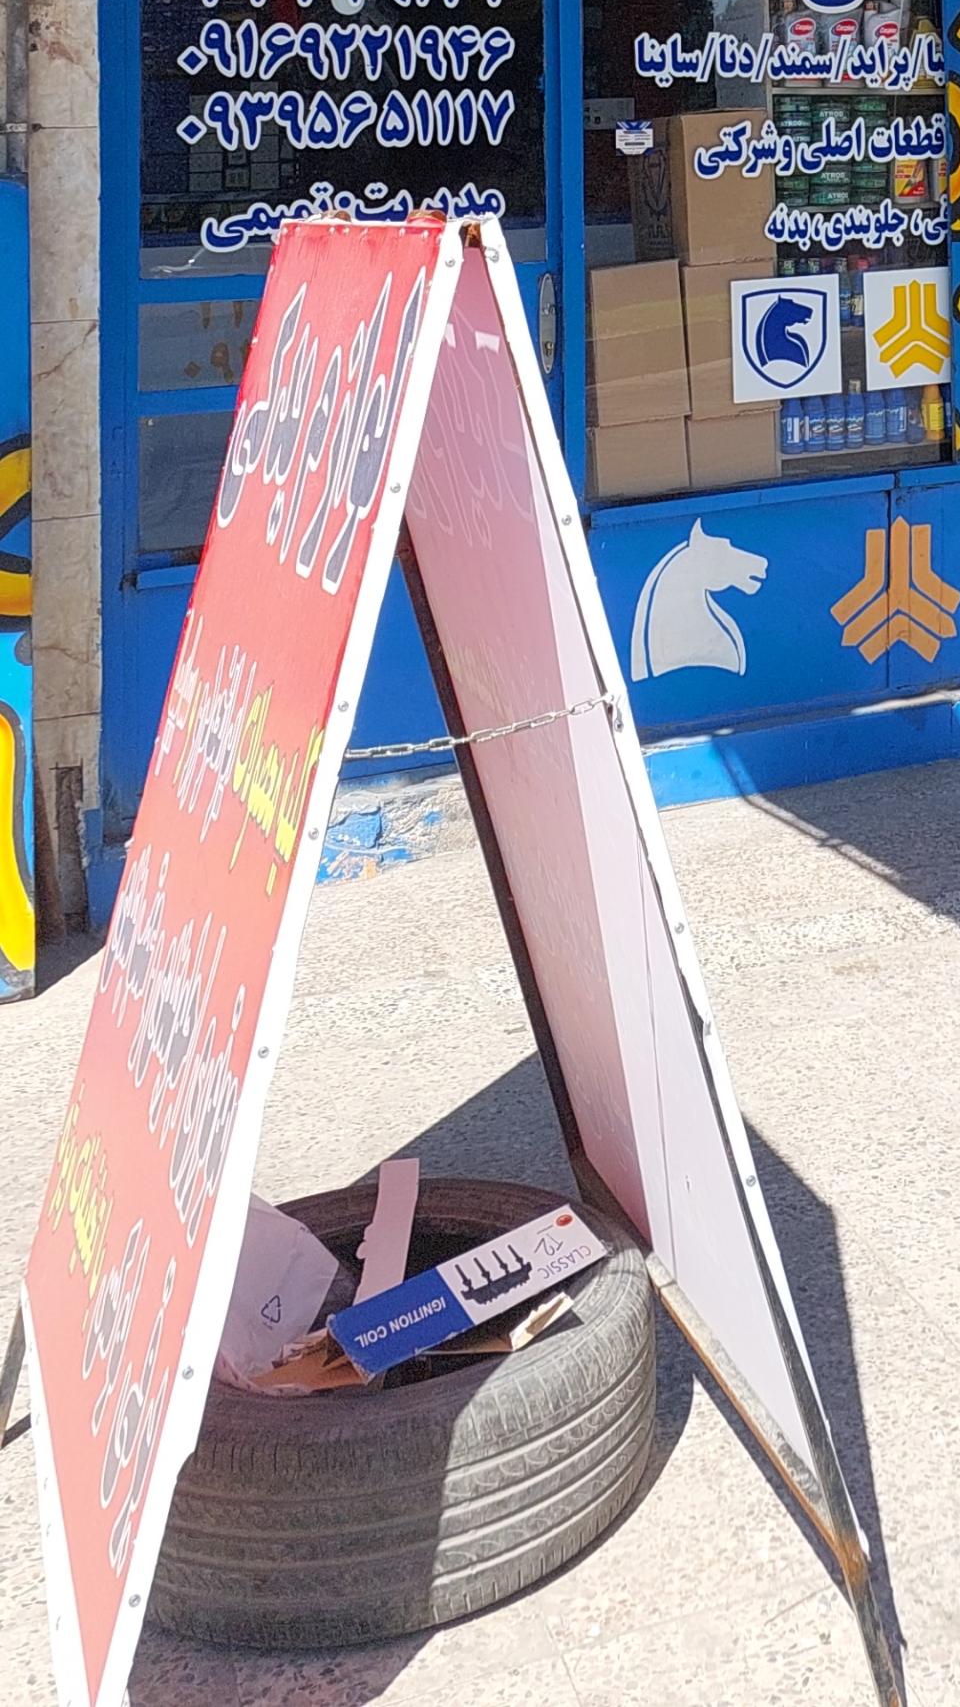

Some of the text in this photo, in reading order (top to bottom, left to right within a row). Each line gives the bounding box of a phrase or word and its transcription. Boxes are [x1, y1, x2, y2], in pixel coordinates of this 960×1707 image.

[178, 20, 514, 80] ۰۹۱۶۹۲۲۱۹۴۶
[177, 90, 514, 150] ۰۹۳۹۵۶۵۱۱۱۷
[797, 117, 865, 173] اصلی
[869, 114, 946, 162] قطعات
[216, 281, 318, 546] یدکی
[279, 265, 427, 595] لوازم
[537, 1245, 592, 1280] CLASSIC
[83, 1219, 151, 1435] لوکس
[353, 1295, 447, 1349] IGNITION COIL
[101, 1256, 176, 1577] برقی
